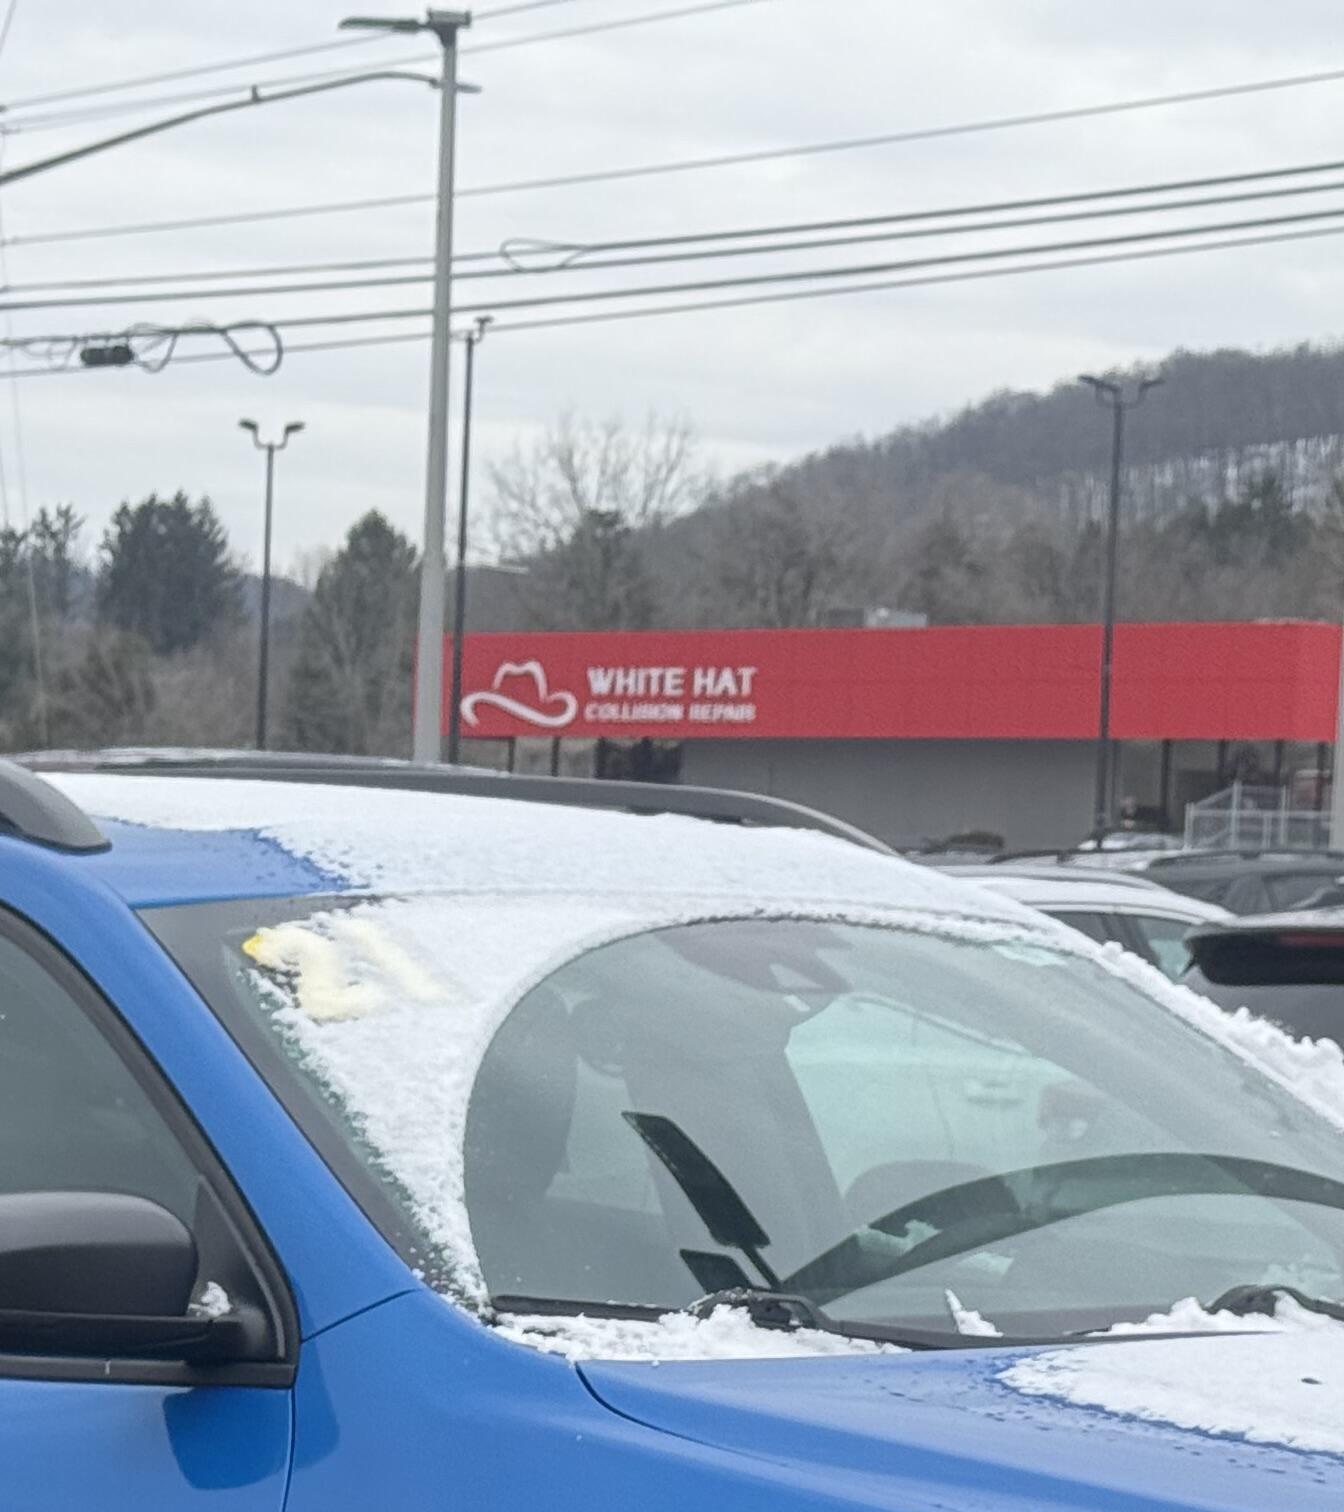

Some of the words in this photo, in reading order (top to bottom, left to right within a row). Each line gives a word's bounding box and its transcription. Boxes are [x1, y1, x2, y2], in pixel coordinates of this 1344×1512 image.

[586, 666, 686, 697] WHITE
[692, 666, 756, 697] HAT
[584, 703, 684, 721] COLLISION
